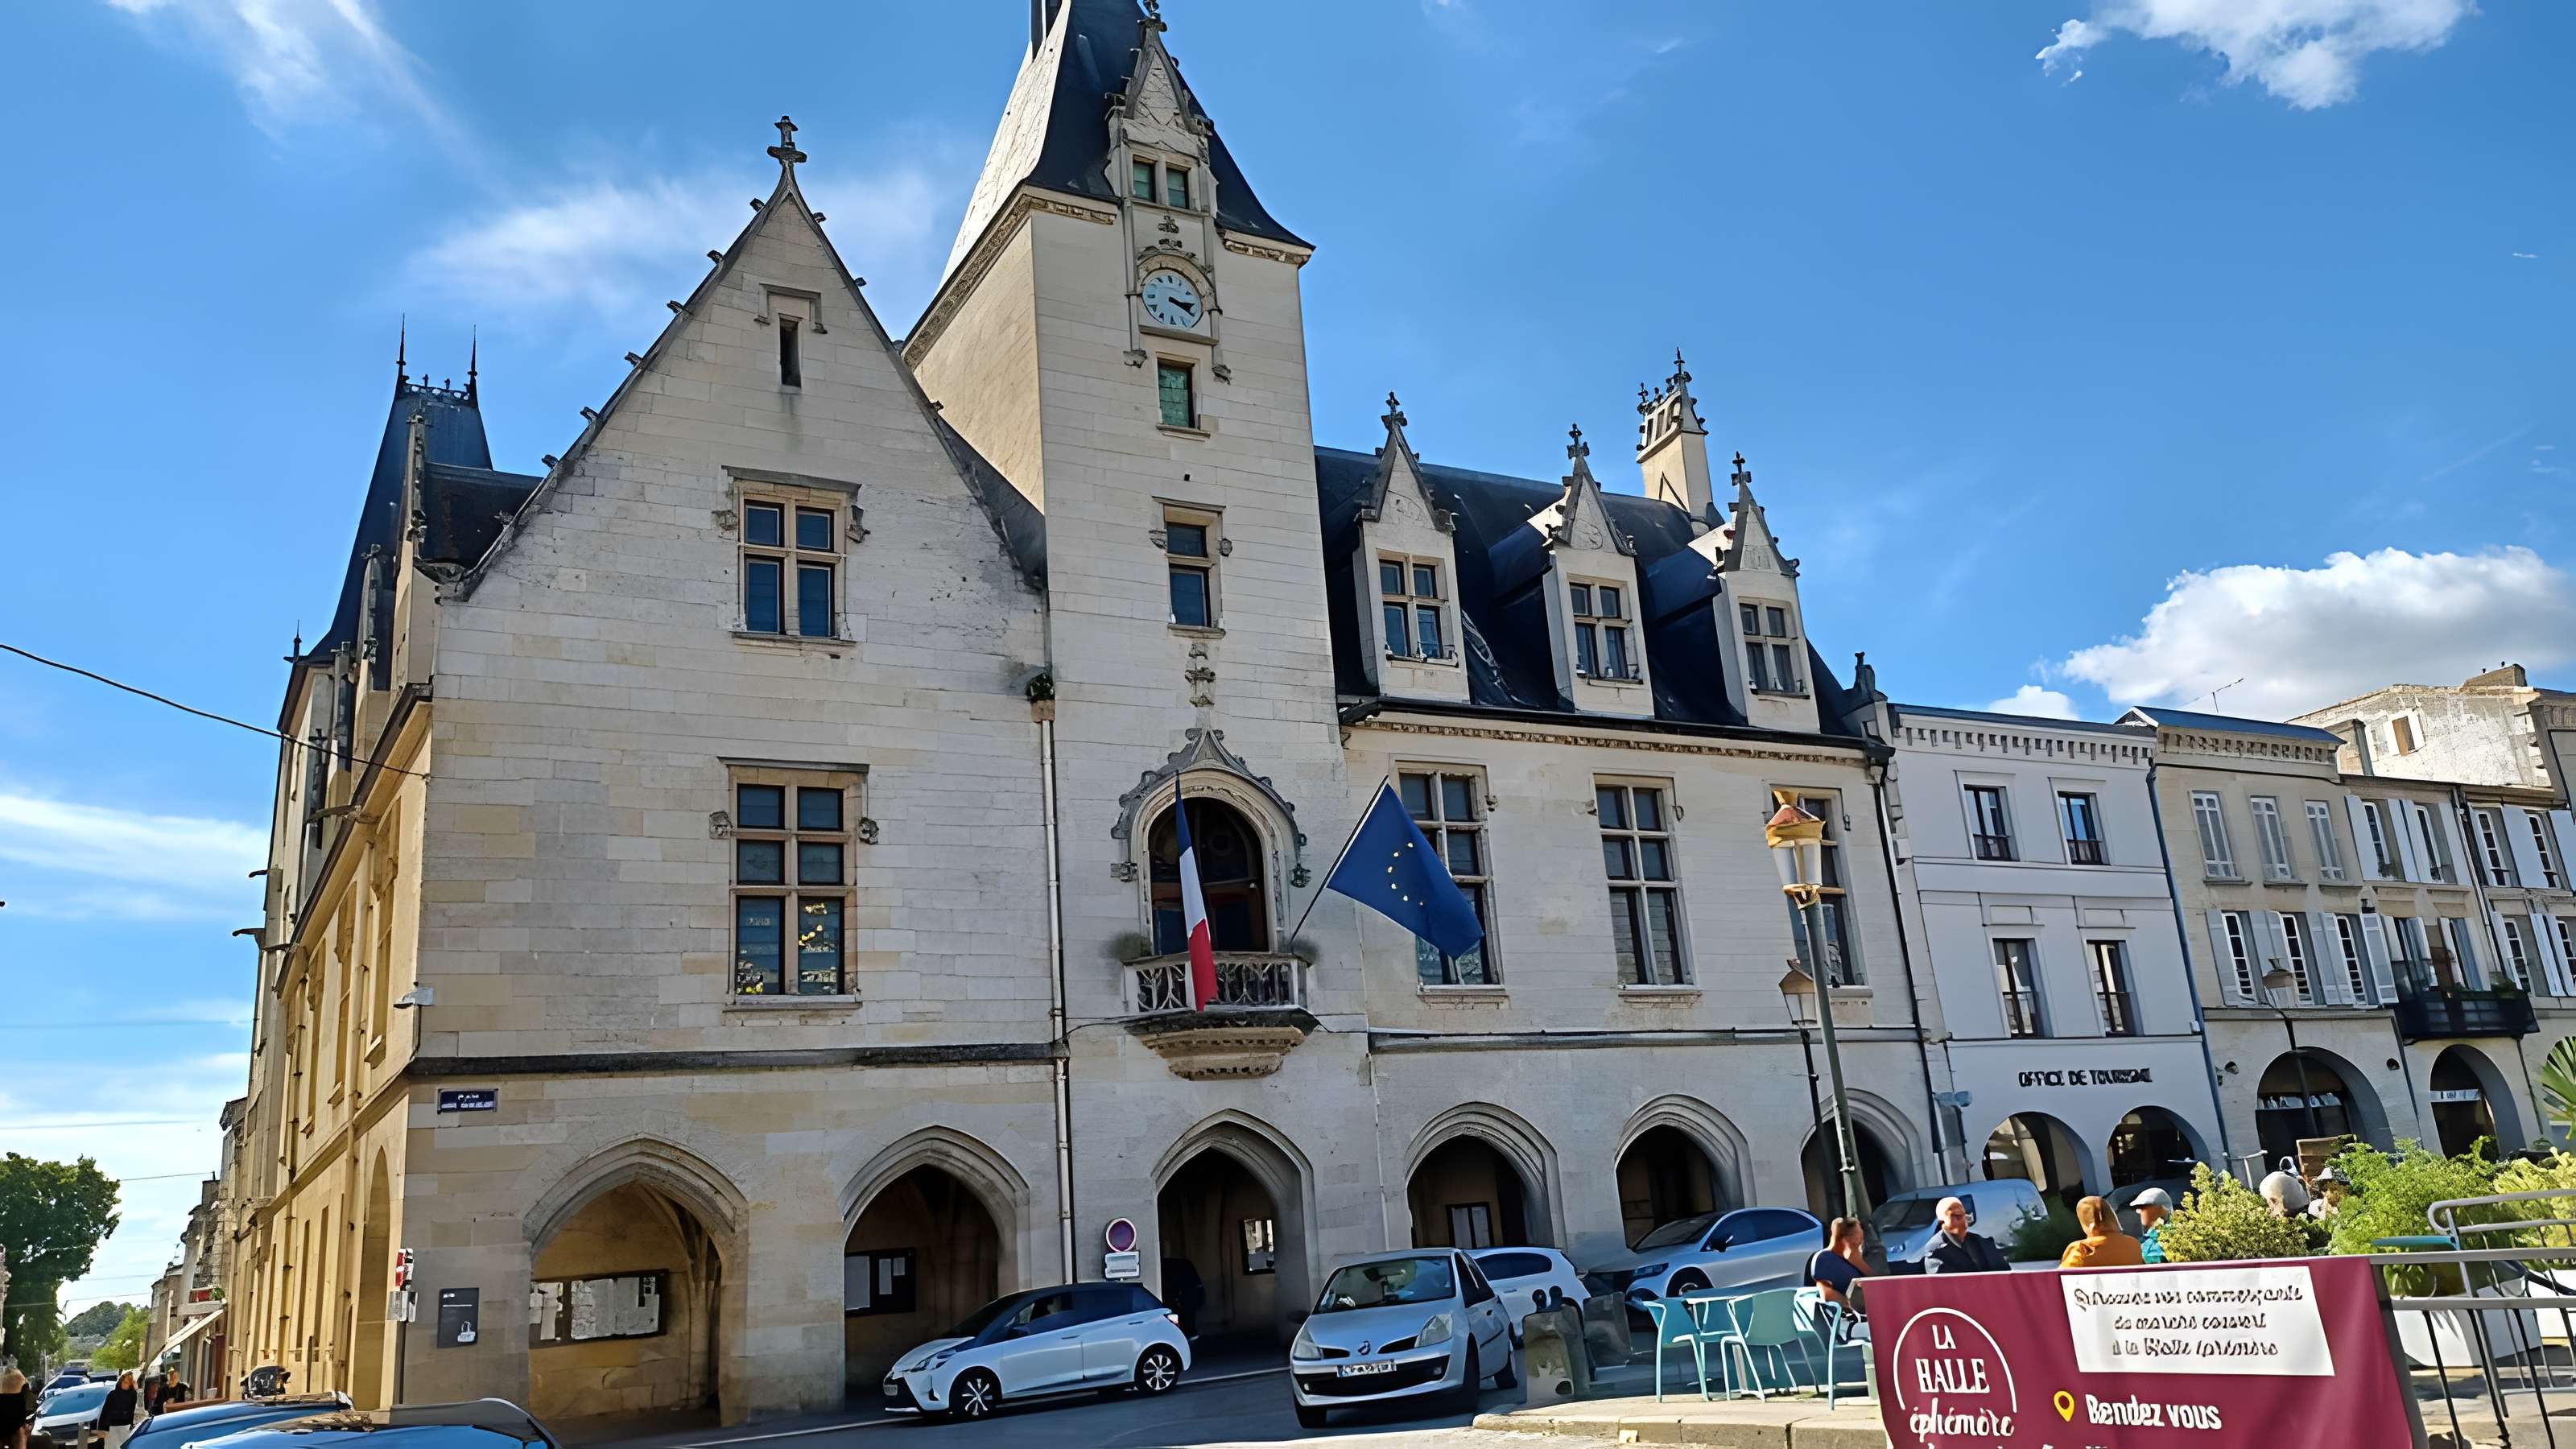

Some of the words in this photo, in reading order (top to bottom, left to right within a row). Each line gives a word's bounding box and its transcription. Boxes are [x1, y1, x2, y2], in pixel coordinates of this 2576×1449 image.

[2068, 1070, 2088, 1085] DE
[1932, 1324, 1957, 1350] LA
[1915, 1358, 1991, 1393] HALLE
[2085, 1393, 2165, 1427] Rendez
[2165, 1404, 2223, 1430] vous
